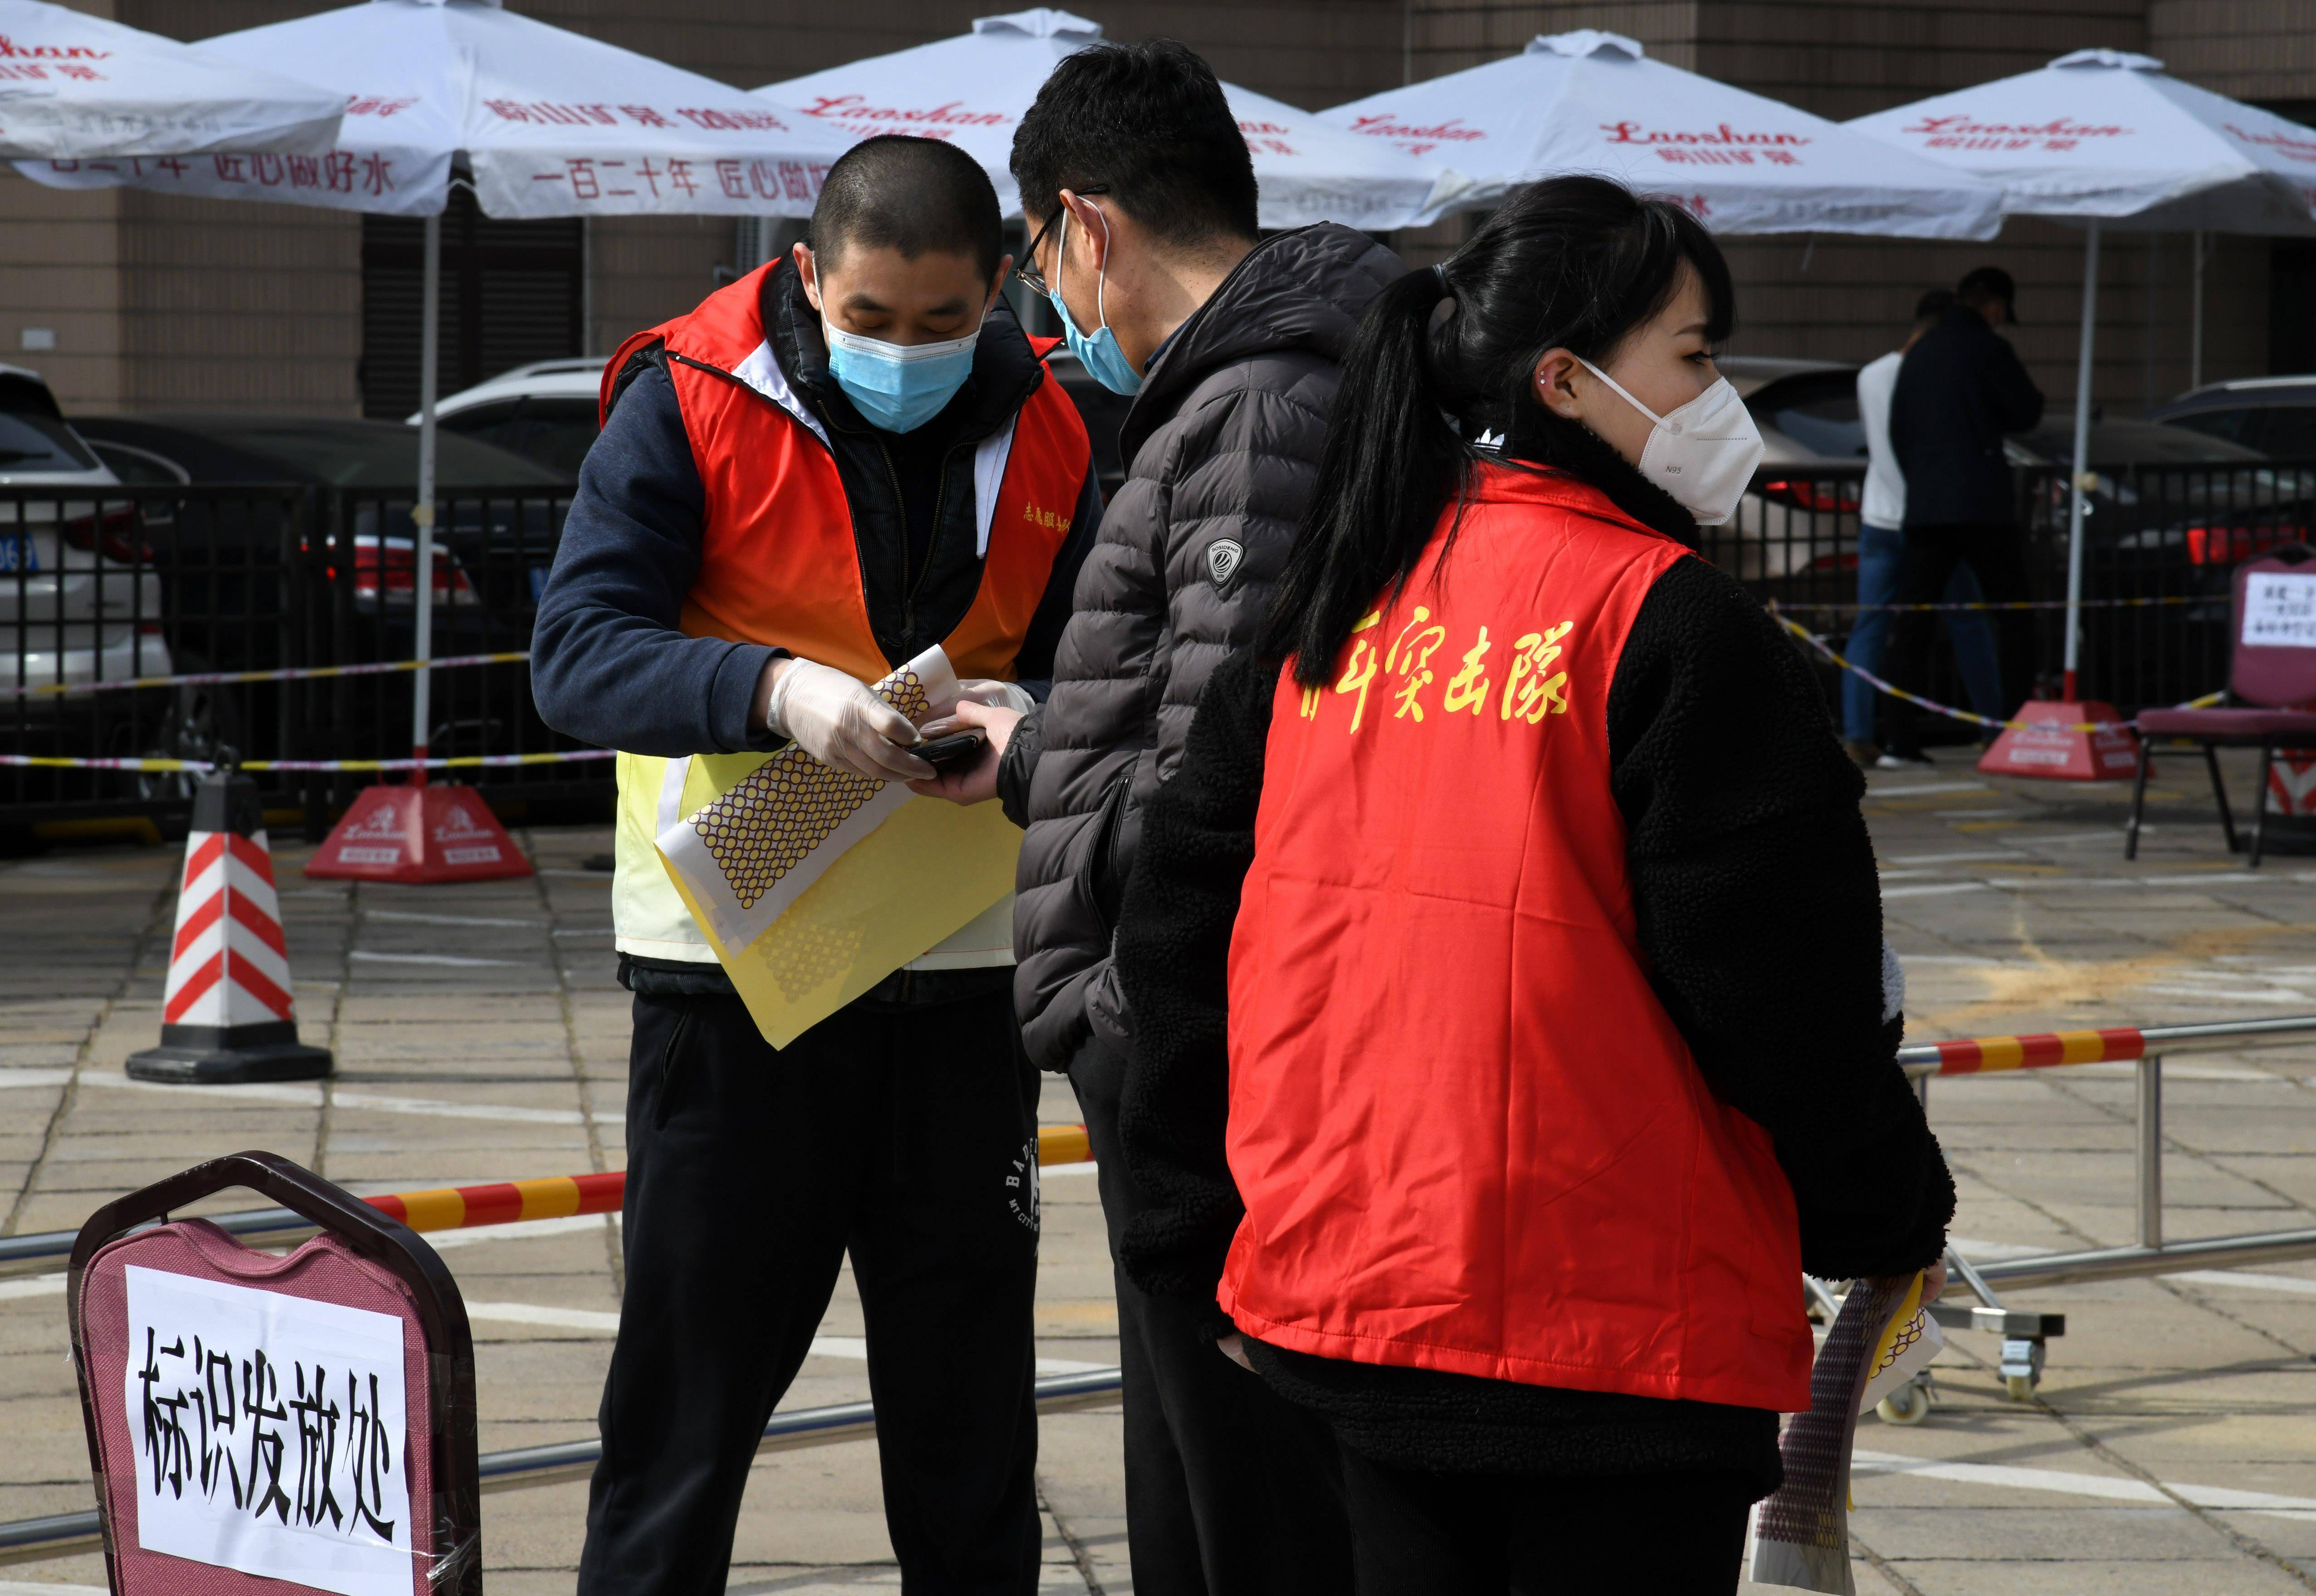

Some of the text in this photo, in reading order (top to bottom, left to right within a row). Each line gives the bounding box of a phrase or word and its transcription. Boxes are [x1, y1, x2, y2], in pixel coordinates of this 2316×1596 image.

[797, 94, 1014, 126] Laoshan
[1599, 121, 1811, 146] Laoshan
[1666, 466, 1682, 474] N95
[1212, 545, 1238, 553] BOSIDENG
[1009, 1198, 1020, 1213] MY
[138, 1326, 395, 1544] 标识发放处
